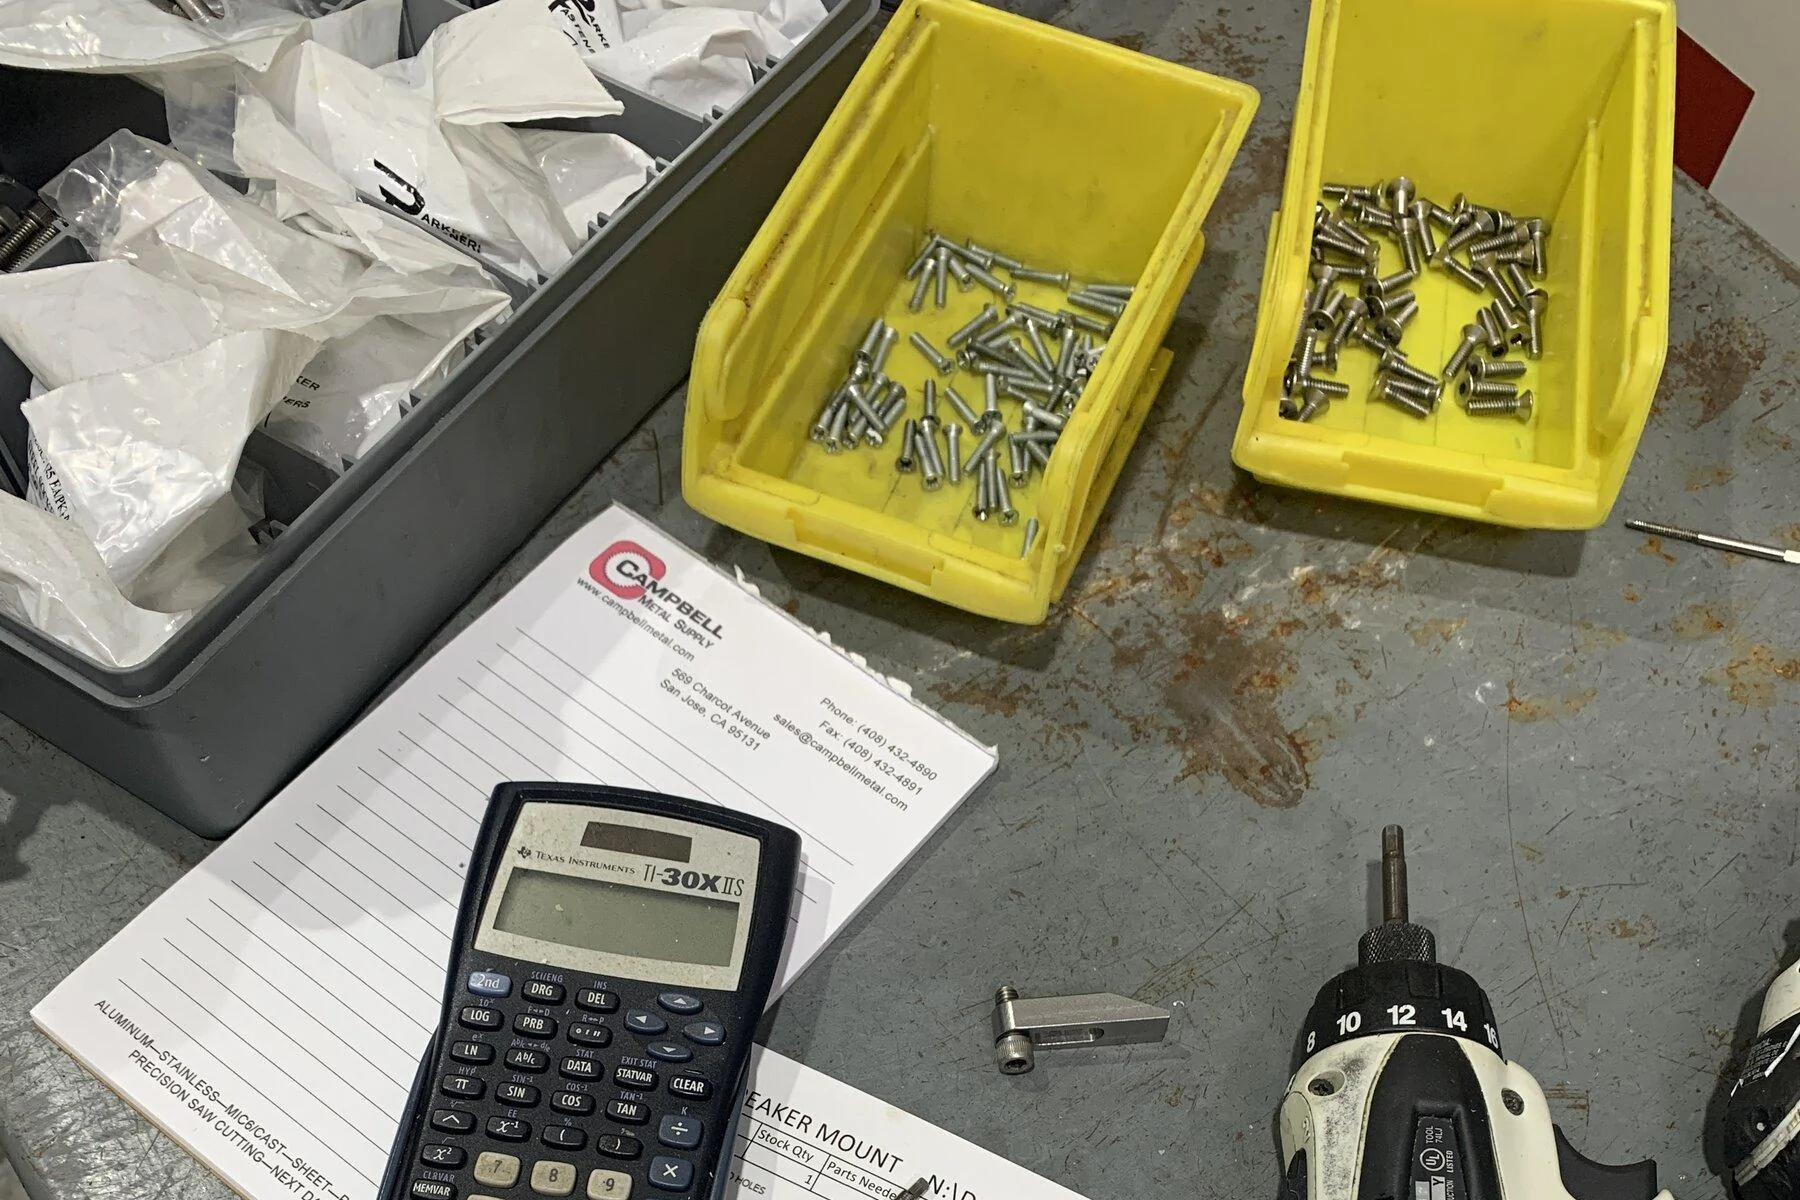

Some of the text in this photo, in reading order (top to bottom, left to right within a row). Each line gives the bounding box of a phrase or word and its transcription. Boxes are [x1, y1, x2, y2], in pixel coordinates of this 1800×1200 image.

[616, 560, 724, 639] CAMPBELL
[577, 578, 694, 662] www.campbellmetal.com
[638, 595, 714, 649] METAL SUPPLY
[672, 668, 771, 739] 569 Charcot Avenue
[660, 679, 760, 750] San Jose, CA 95131
[819, 697, 938, 781] Phone: (408) 432-4890
[773, 713, 908, 812] sales@campbellmetal.com
[819, 720, 923, 796] Fax: (408) 432-4891
[535, 850, 565, 863] TEXAS
[568, 856, 636, 875] INSTRUMENTS
[477, 973, 500, 989] 2nd
[593, 980, 608, 990] INS
[531, 983, 554, 996] DRG
[587, 992, 606, 1005] DEL
[470, 1009, 490, 1022] LOG
[522, 1016, 544, 1030] PRB
[1306, 1030, 1316, 1053] 8
[1336, 1011, 1361, 1036] 10
[1387, 1004, 1416, 1025] 12
[1440, 1007, 1468, 1032] 14
[464, 1044, 478, 1056] LN
[576, 1049, 594, 1058] STAT
[567, 1060, 592, 1074] DATA
[621, 1056, 657, 1069] EXIT STAT
[616, 1068, 653, 1083] STATVAR
[128, 1050, 190, 1102] PRECISION
[188, 1098, 218, 1123] SAW
[507, 1086, 526, 1098] SIN
[673, 1078, 704, 1093] CLEAR
[562, 1094, 582, 1107] COS
[507, 1109, 518, 1118] EE
[617, 1103, 637, 1116] TAN
[681, 1107, 687, 1115] K
[757, 1129, 814, 1163] Stock Qty
[815, 1123, 904, 1173] MOUNT
[493, 1159, 503, 1174] 7
[423, 1170, 455, 1182] CLRVAR
[550, 1168, 559, 1183] 8
[804, 1174, 813, 1185] 1
[826, 1161, 897, 1200] Parts Neede
[413, 1182, 451, 1196] MEMVAR
[605, 1177, 615, 1192] 9
[734, 1176, 767, 1195] HOLES
